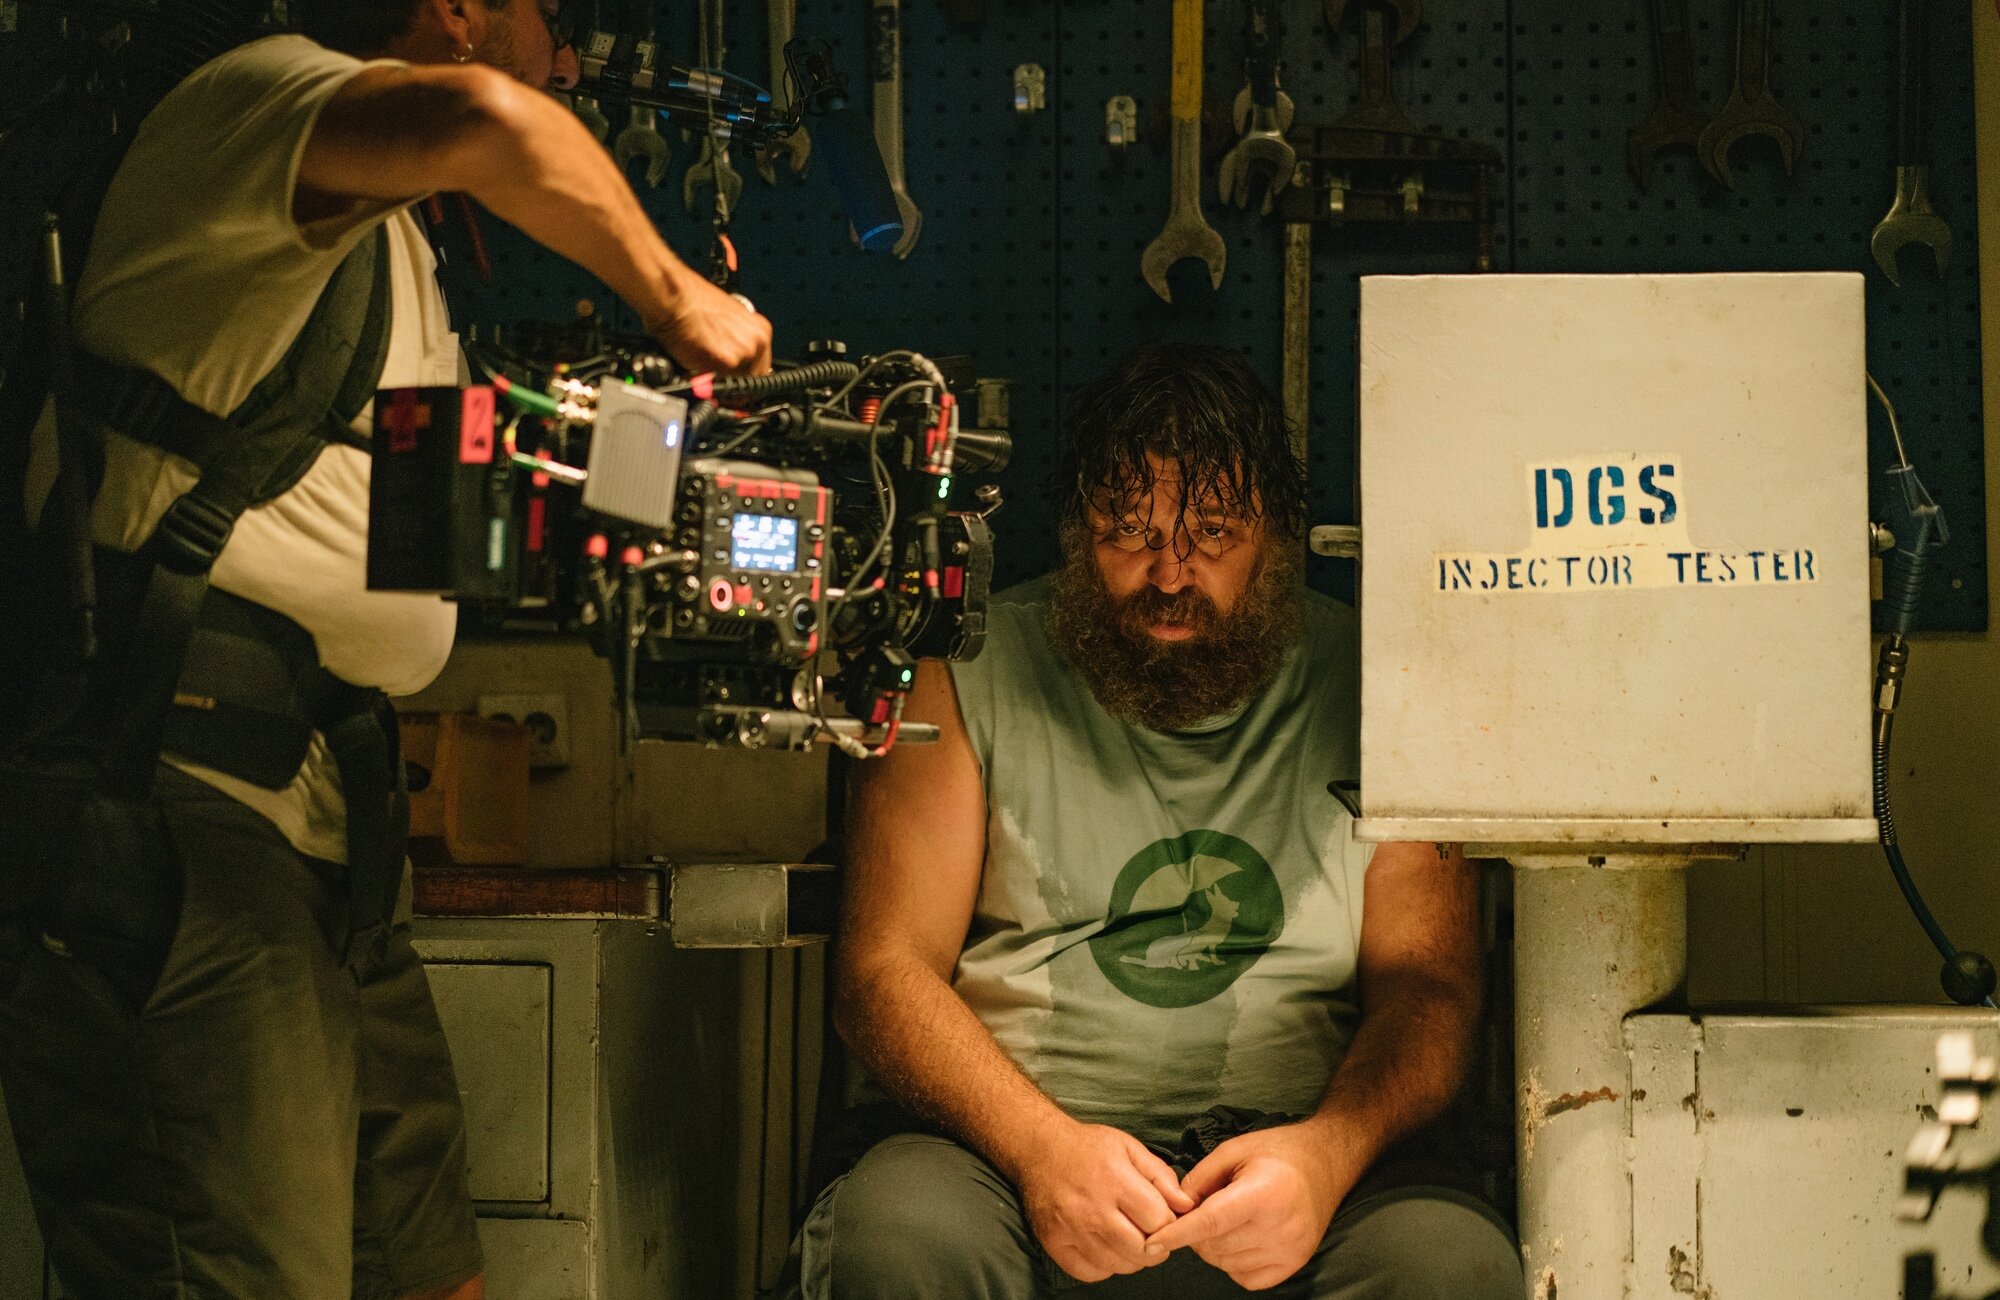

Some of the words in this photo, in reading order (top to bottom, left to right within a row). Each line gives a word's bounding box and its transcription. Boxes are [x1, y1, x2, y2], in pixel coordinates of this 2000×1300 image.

[1535, 464, 1677, 528] DGS
[1439, 555, 1632, 590] INJECTOR
[1667, 550, 1815, 583] TESTER
